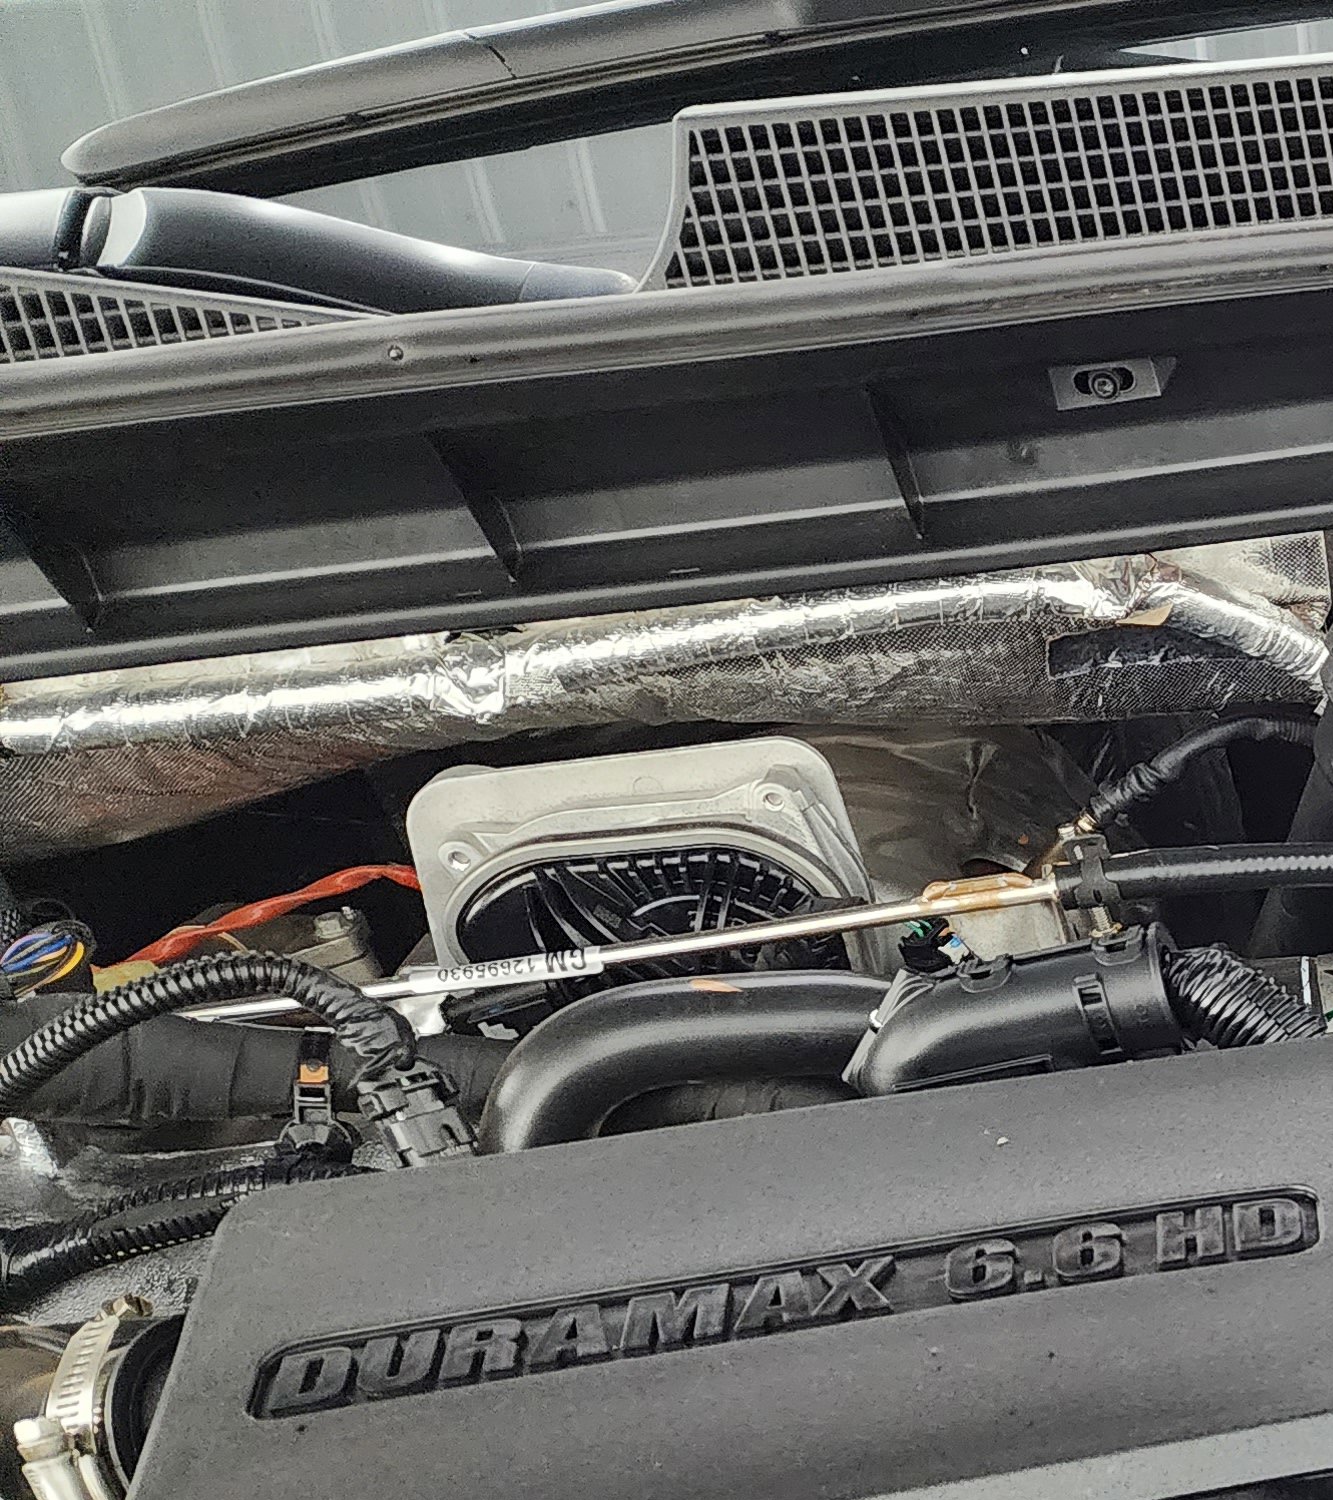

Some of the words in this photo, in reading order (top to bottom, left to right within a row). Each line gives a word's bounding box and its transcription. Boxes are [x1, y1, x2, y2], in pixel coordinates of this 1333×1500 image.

[436, 957, 537, 983] 12695930
[544, 949, 587, 974] GM
[266, 1254, 897, 1413] DURAMAX
[944, 1221, 1125, 1301] 6.6
[1153, 1198, 1307, 1271] HD
